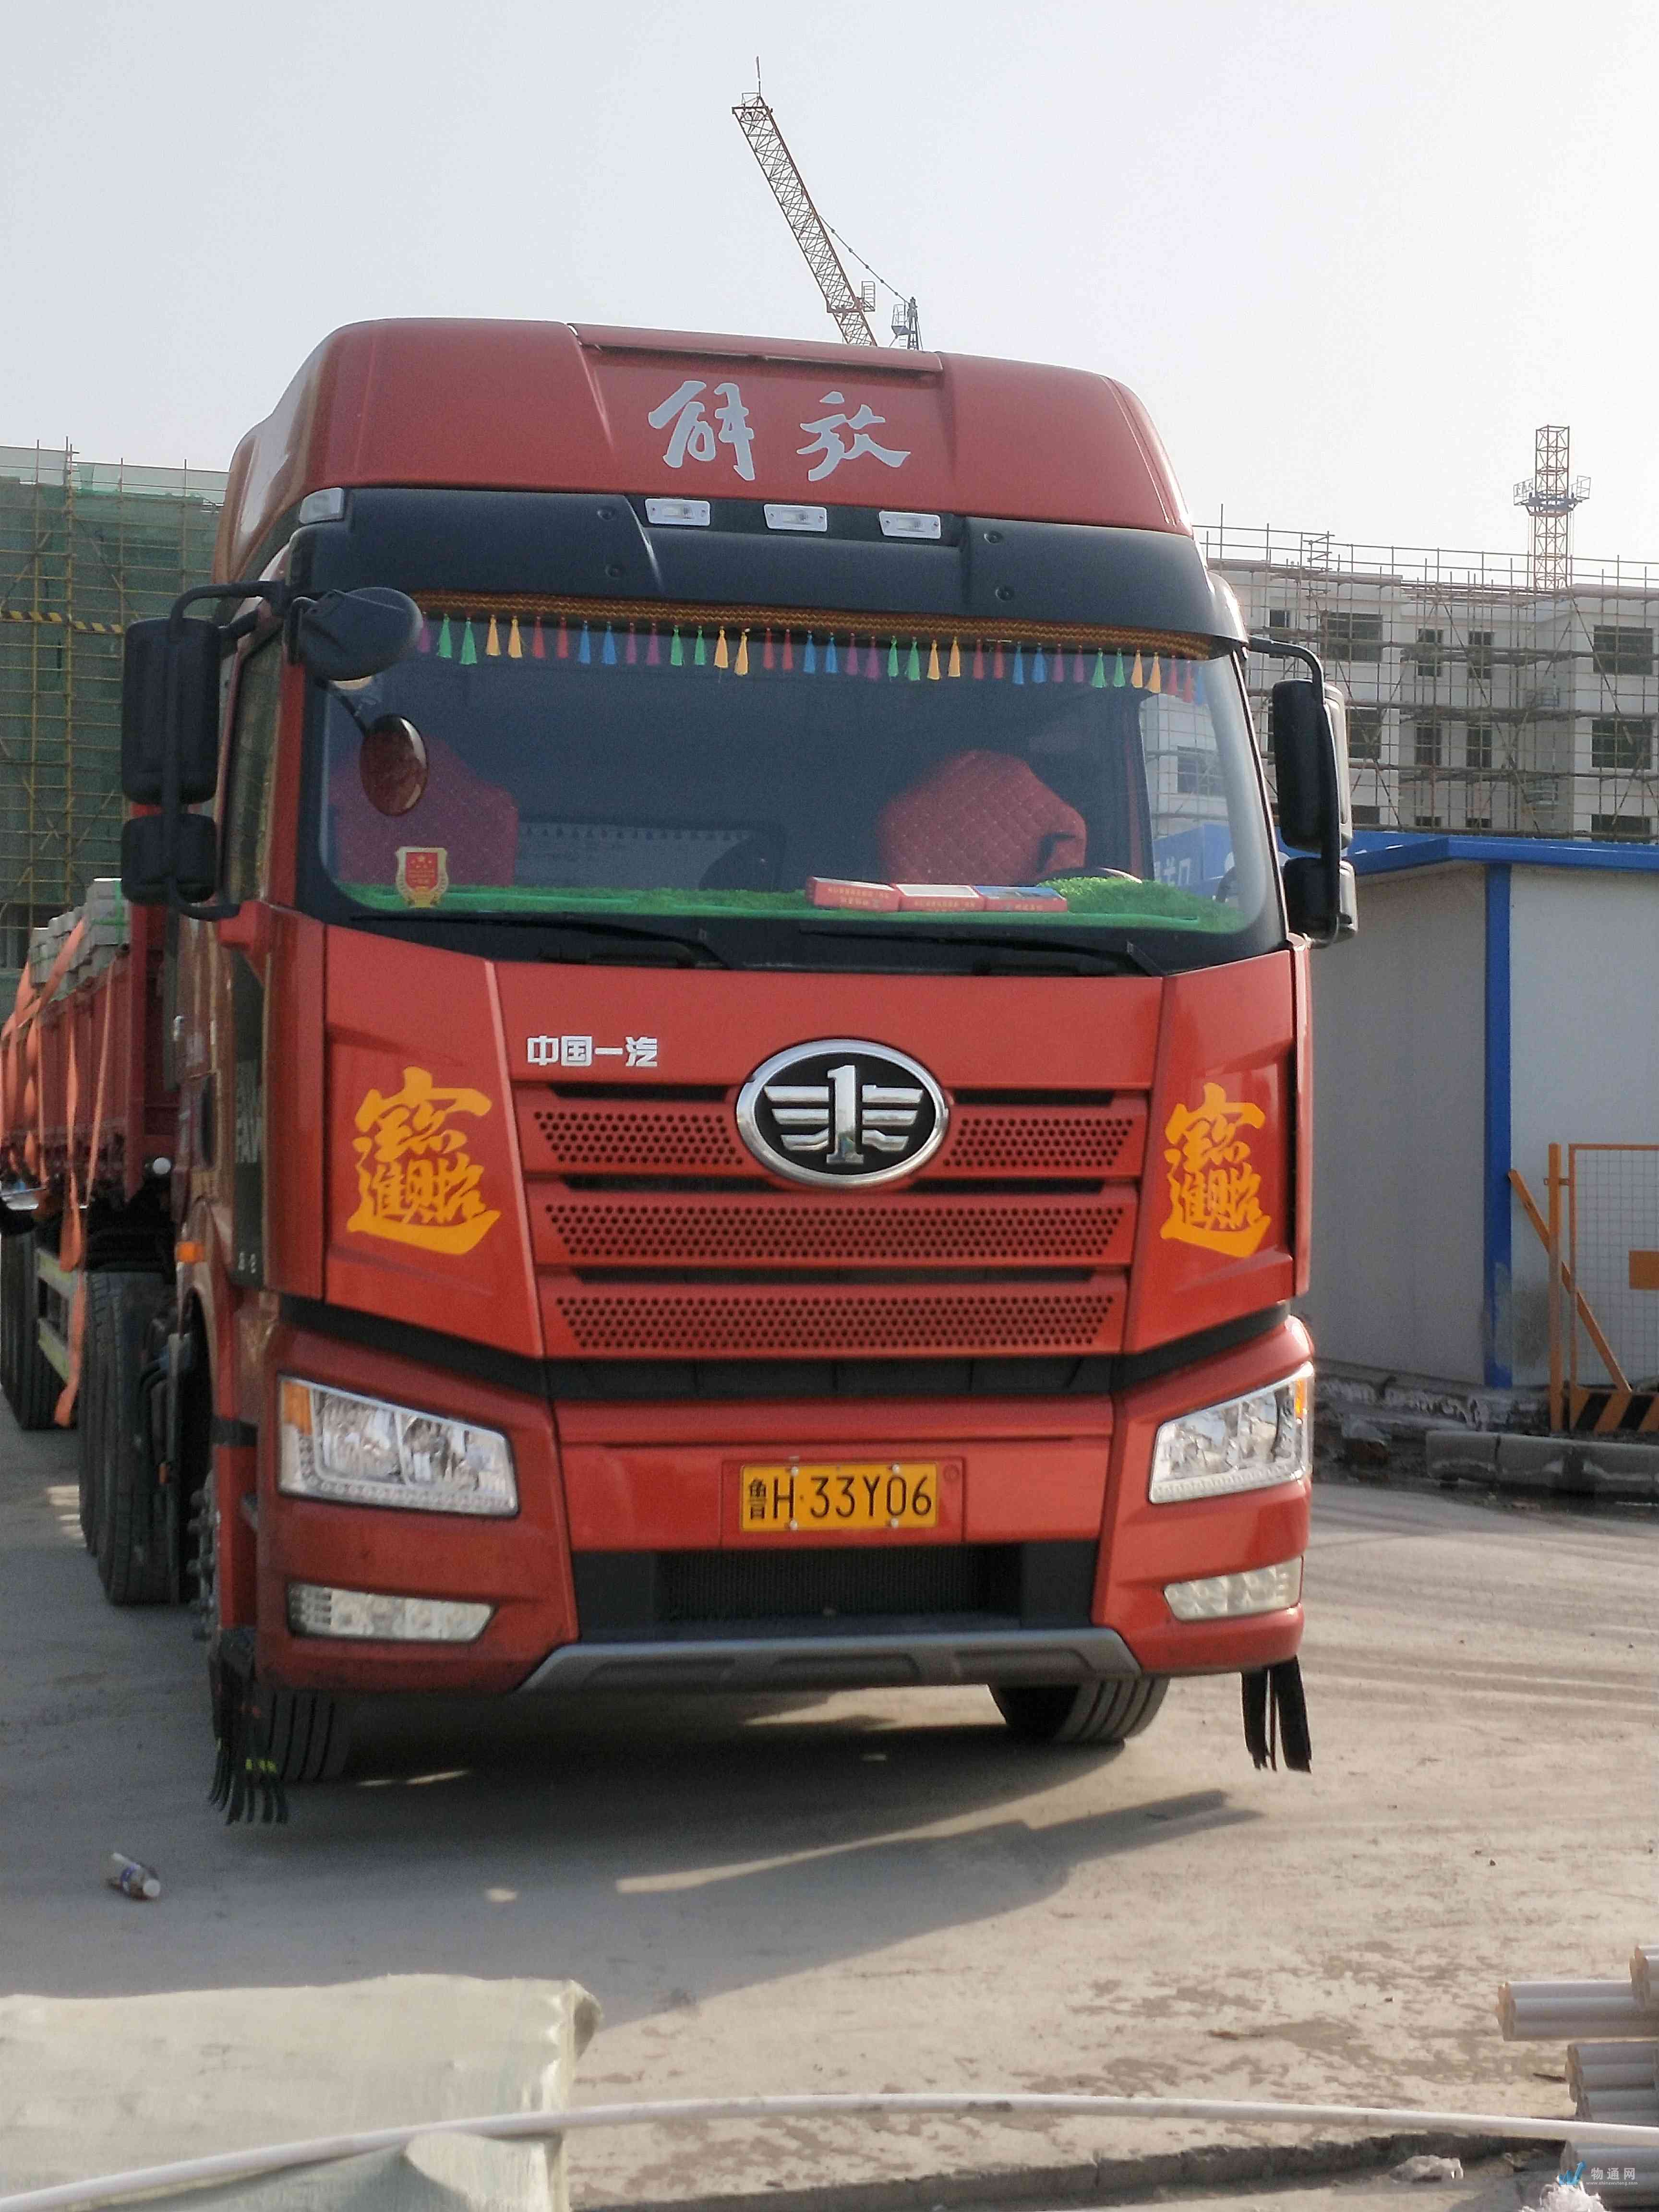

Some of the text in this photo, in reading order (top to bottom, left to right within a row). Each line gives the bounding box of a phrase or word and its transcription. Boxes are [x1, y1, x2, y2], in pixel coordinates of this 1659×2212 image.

[648, 381, 911, 481] 解放
[527, 1035, 658, 1067] 中国一汽
